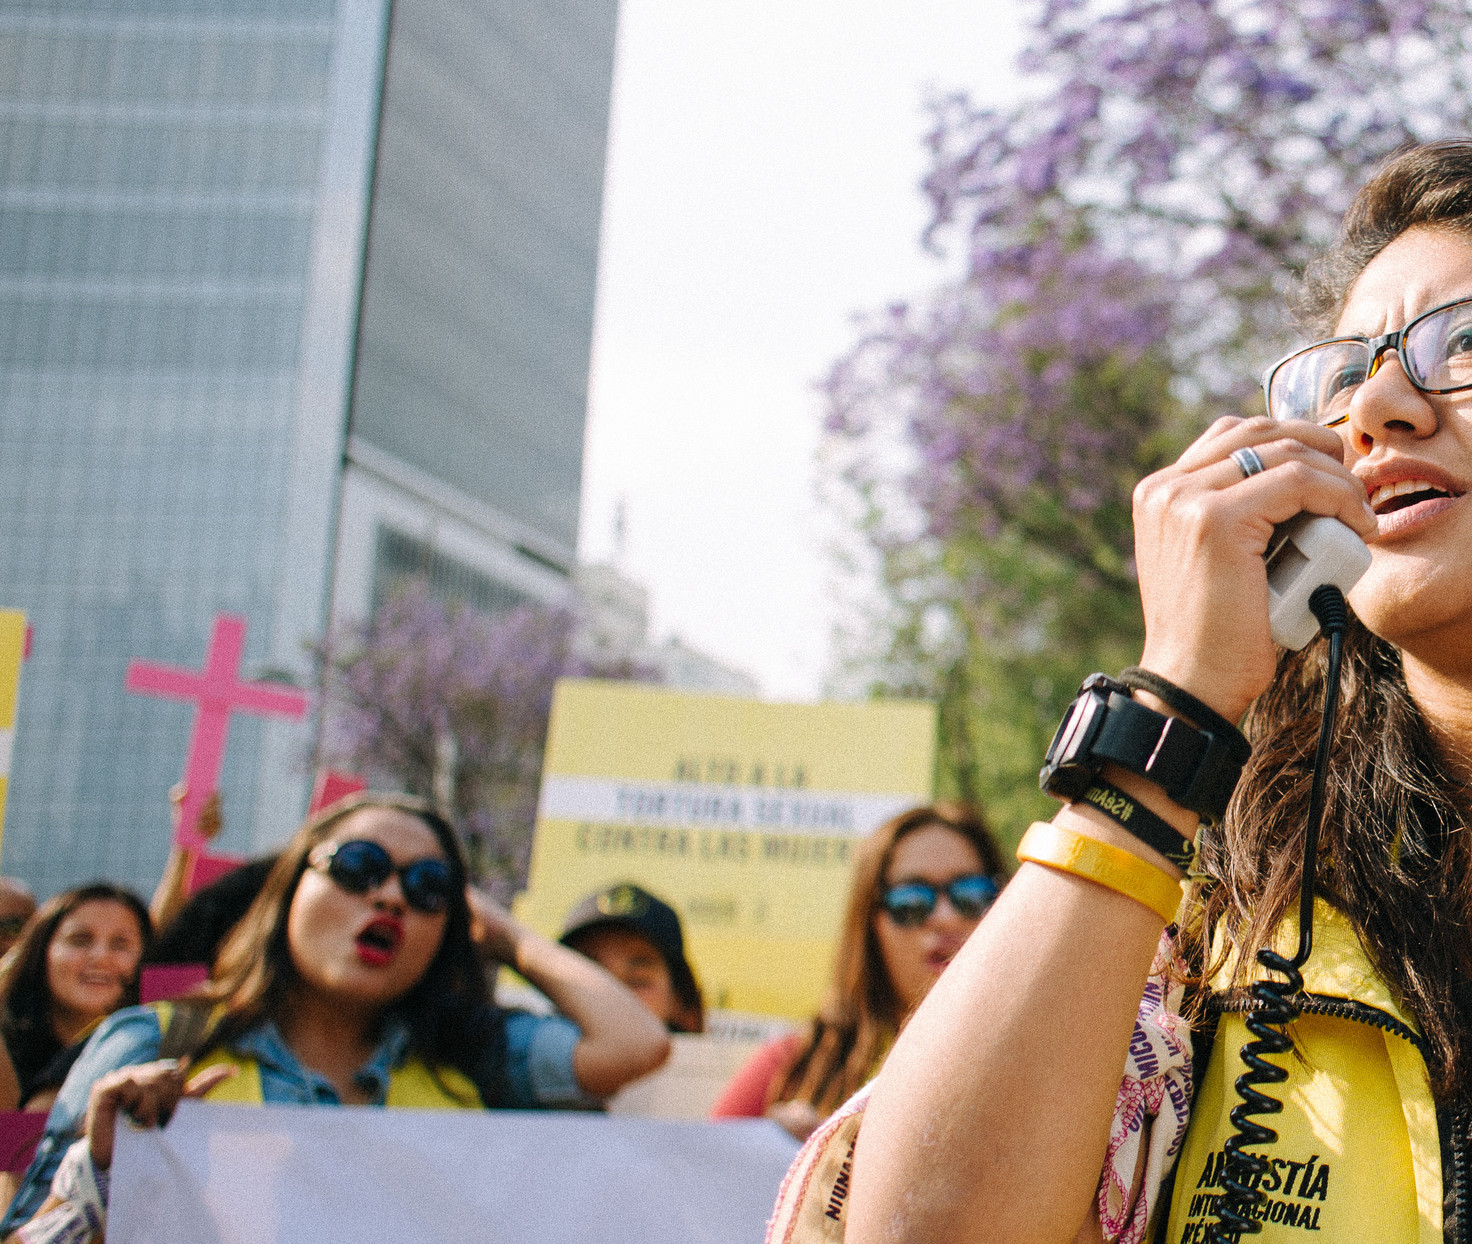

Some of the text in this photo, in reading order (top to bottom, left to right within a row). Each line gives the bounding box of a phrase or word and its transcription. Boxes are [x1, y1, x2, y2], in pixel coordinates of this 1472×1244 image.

[761, 836, 850, 866] MUJER
[1129, 1021, 1159, 1080] MICU
[825, 1141, 857, 1221] NIUNA
